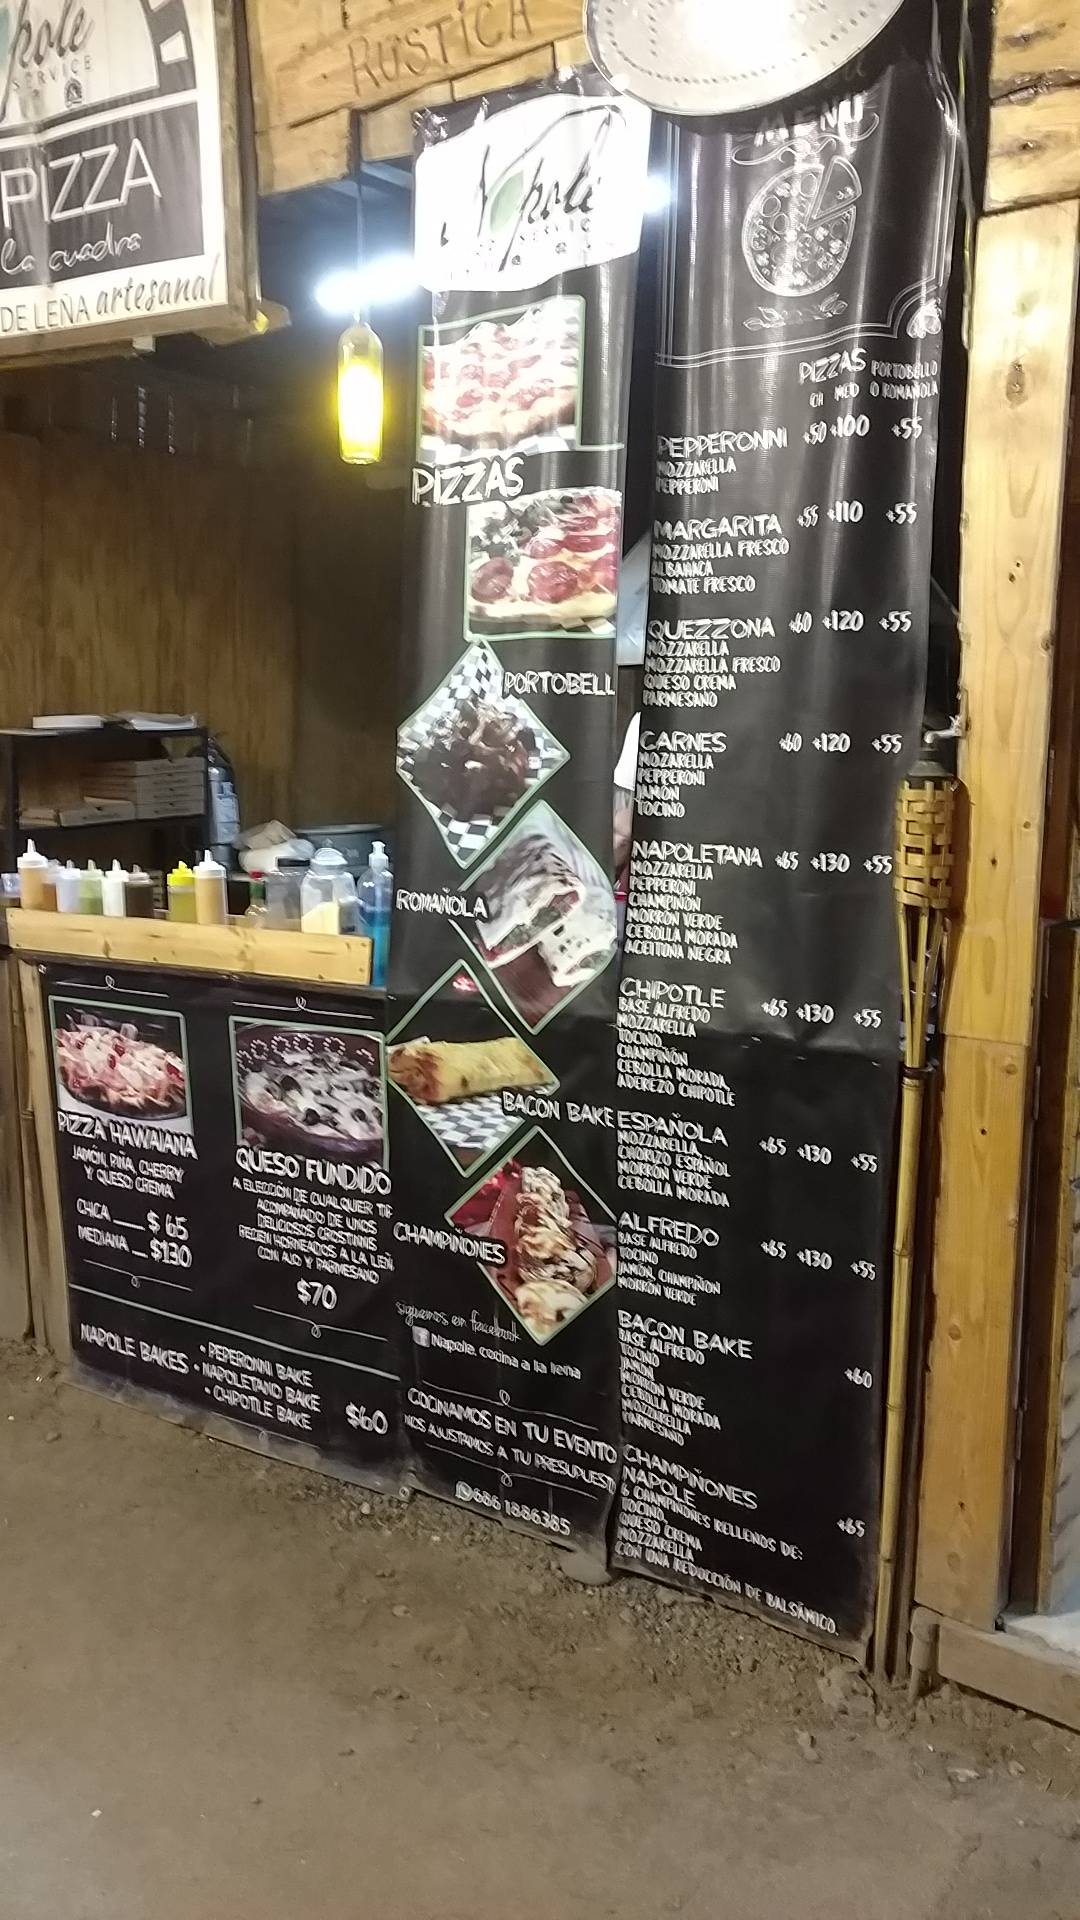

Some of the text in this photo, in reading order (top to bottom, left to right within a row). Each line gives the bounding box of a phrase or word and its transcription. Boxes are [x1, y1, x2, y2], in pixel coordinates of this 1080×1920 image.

[349, 0, 532, 97] RUSTICA
[0, 138, 162, 230] PIZZA
[1, 221, 142, 274] la cuadra
[1, 254, 220, 333] DE LEÑA artesanal
[800, 347, 938, 385] PIZZAS PORTOBELLO
[835, 381, 860, 401] MED
[657, 427, 788, 458] PEPPERONNI
[655, 456, 736, 478] MOZZARELLA
[411, 456, 524, 506] PIZZAS
[655, 476, 719, 495] PEPPERONI
[653, 514, 782, 541] MARGARITA
[652, 537, 790, 561] MOZZARELLA FRESCO
[703, 574, 756, 594] FRESCO
[648, 617, 776, 640] QUEZZONA
[645, 640, 729, 657] MOZZARELLA
[644, 656, 781, 674] MOZZARELLA FRESCO
[503, 669, 616, 695] PORTOBELL
[643, 673, 737, 691] QUESO CREMA
[642, 690, 718, 707] PARMESANO
[640, 731, 727, 753] CARNES
[637, 767, 705, 786] PEPPERONI
[637, 800, 685, 818] TOCINO
[631, 840, 763, 868] NAPOLETANA
[630, 860, 714, 880] MOZZARELLA
[629, 875, 696, 896] PEPPERONI
[682, 913, 723, 931] VERDE
[626, 923, 738, 949] CEBOLLA MORADA
[624, 938, 732, 964] ACEITUNA NEGRA
[619, 977, 726, 1009] CHIPOTLE
[618, 996, 711, 1023] BASE ALFREDO
[616, 1012, 697, 1038] MOZZARELLA
[616, 1058, 673, 1079] CEBOLLA
[616, 1073, 736, 1107] ADEREZO CHIPOTLE
[502, 1091, 615, 1129] BACON BAKE
[57, 1111, 198, 1160] PIZZA HAWAIANA
[617, 1111, 729, 1147] ESPAÑOLA
[617, 1130, 699, 1155] MOZZARELLA
[138, 1159, 185, 1183] CHERRY
[236, 1147, 392, 1195] QUESO FUNDIDO
[617, 1145, 731, 1177] CHORIZO ESPAÑOL
[84, 1165, 175, 1200] Y QUESO CREMA
[232, 1176, 308, 1204] A DE
[617, 1175, 730, 1208] CEBOLLA MORADA
[673, 1168, 713, 1190] VERDE
[76, 1198, 111, 1221] CHICA
[327, 1212, 378, 1235] DE UNOS
[618, 1211, 720, 1247] ALFREDO
[77, 1225, 192, 1268] MEDIANA $130
[340, 1247, 350, 1261] A
[351, 1249, 368, 1266] LA
[393, 1221, 506, 1265] CHAMPIÑONES
[617, 1231, 697, 1259] BASE ALFREDO
[618, 1246, 659, 1265] TOCINO
[257, 1245, 280, 1261] CON
[281, 1251, 302, 1266] AJO
[303, 1255, 314, 1269] Y
[297, 1278, 338, 1310] $70
[663, 1285, 697, 1306] VERDE
[618, 1309, 685, 1345] BACON
[693, 1330, 753, 1360] BAKE
[618, 1328, 705, 1366] BASE ALFREDO
[80, 1323, 189, 1374] NAPOLE BAKES
[479, 1346, 519, 1369] cocina
[276, 1364, 312, 1388] BAKE
[213, 1386, 312, 1430] CHIPOTLE BAKE
[285, 1386, 320, 1412] BAKE
[666, 1385, 706, 1411] VERDE
[345, 1402, 389, 1435] $60
[407, 1387, 618, 1464] COCINAMOS EN TU EVENTO
[404, 1414, 426, 1433] NOS
[497, 1445, 509, 1460] A
[511, 1448, 532, 1466] TU
[622, 1465, 697, 1509] NAPOLE
[623, 1444, 758, 1511] CHAMPIÑONES
[713, 1518, 777, 1552] RELLENOS
[614, 1540, 642, 1559] CON
[744, 1582, 762, 1601] DE
